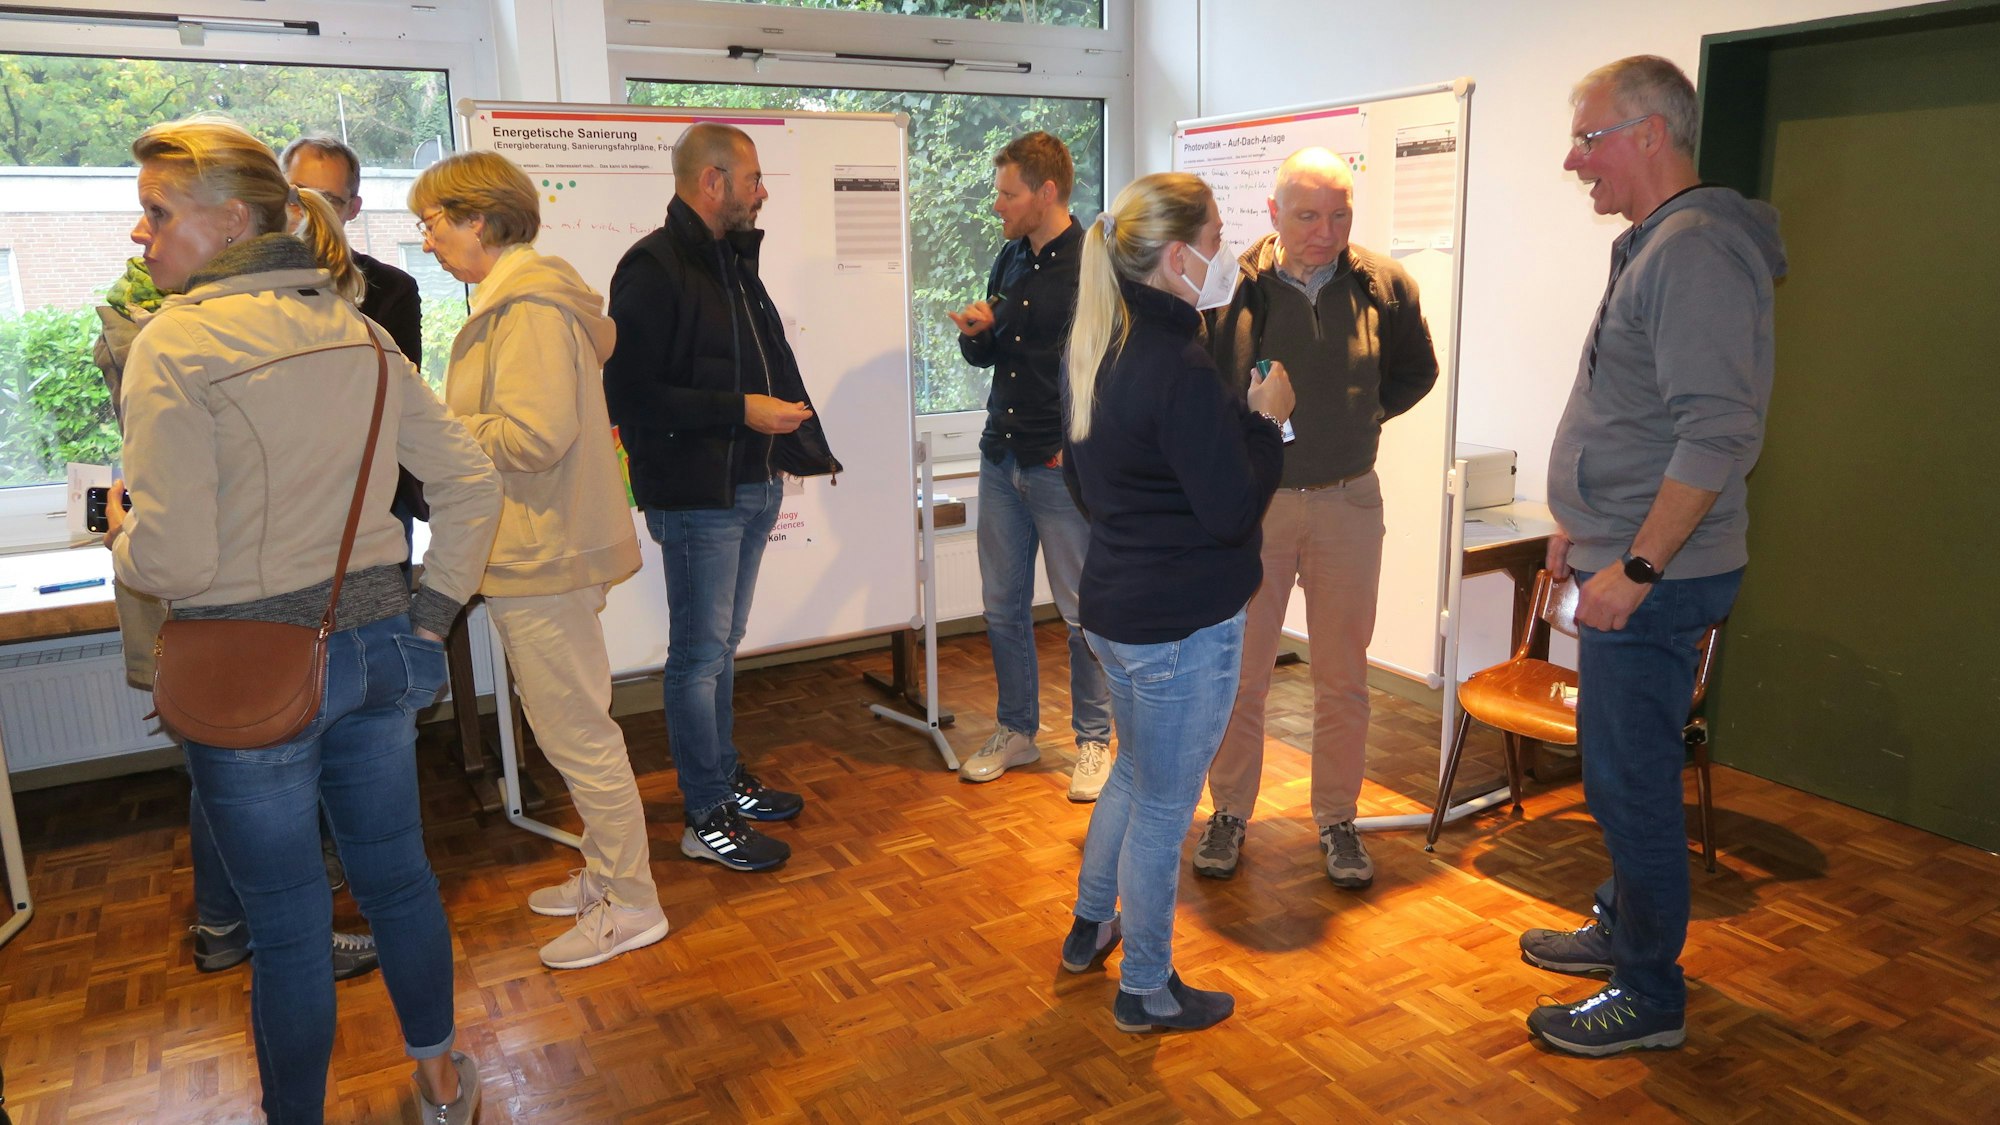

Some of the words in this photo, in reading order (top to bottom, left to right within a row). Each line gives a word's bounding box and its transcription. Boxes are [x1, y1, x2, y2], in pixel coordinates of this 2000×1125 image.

[493, 126, 574, 140] Energetische
[578, 128, 638, 142] Sanierung
[494, 141, 570, 152] (Energieberatung,
[572, 142, 657, 152] Sanierungsfahrpläne,
[1184, 141, 1221, 152] Photovoltaik
[1228, 134, 1286, 148] Auf-Dach-Anlage
[768, 533, 787, 542] Köln
